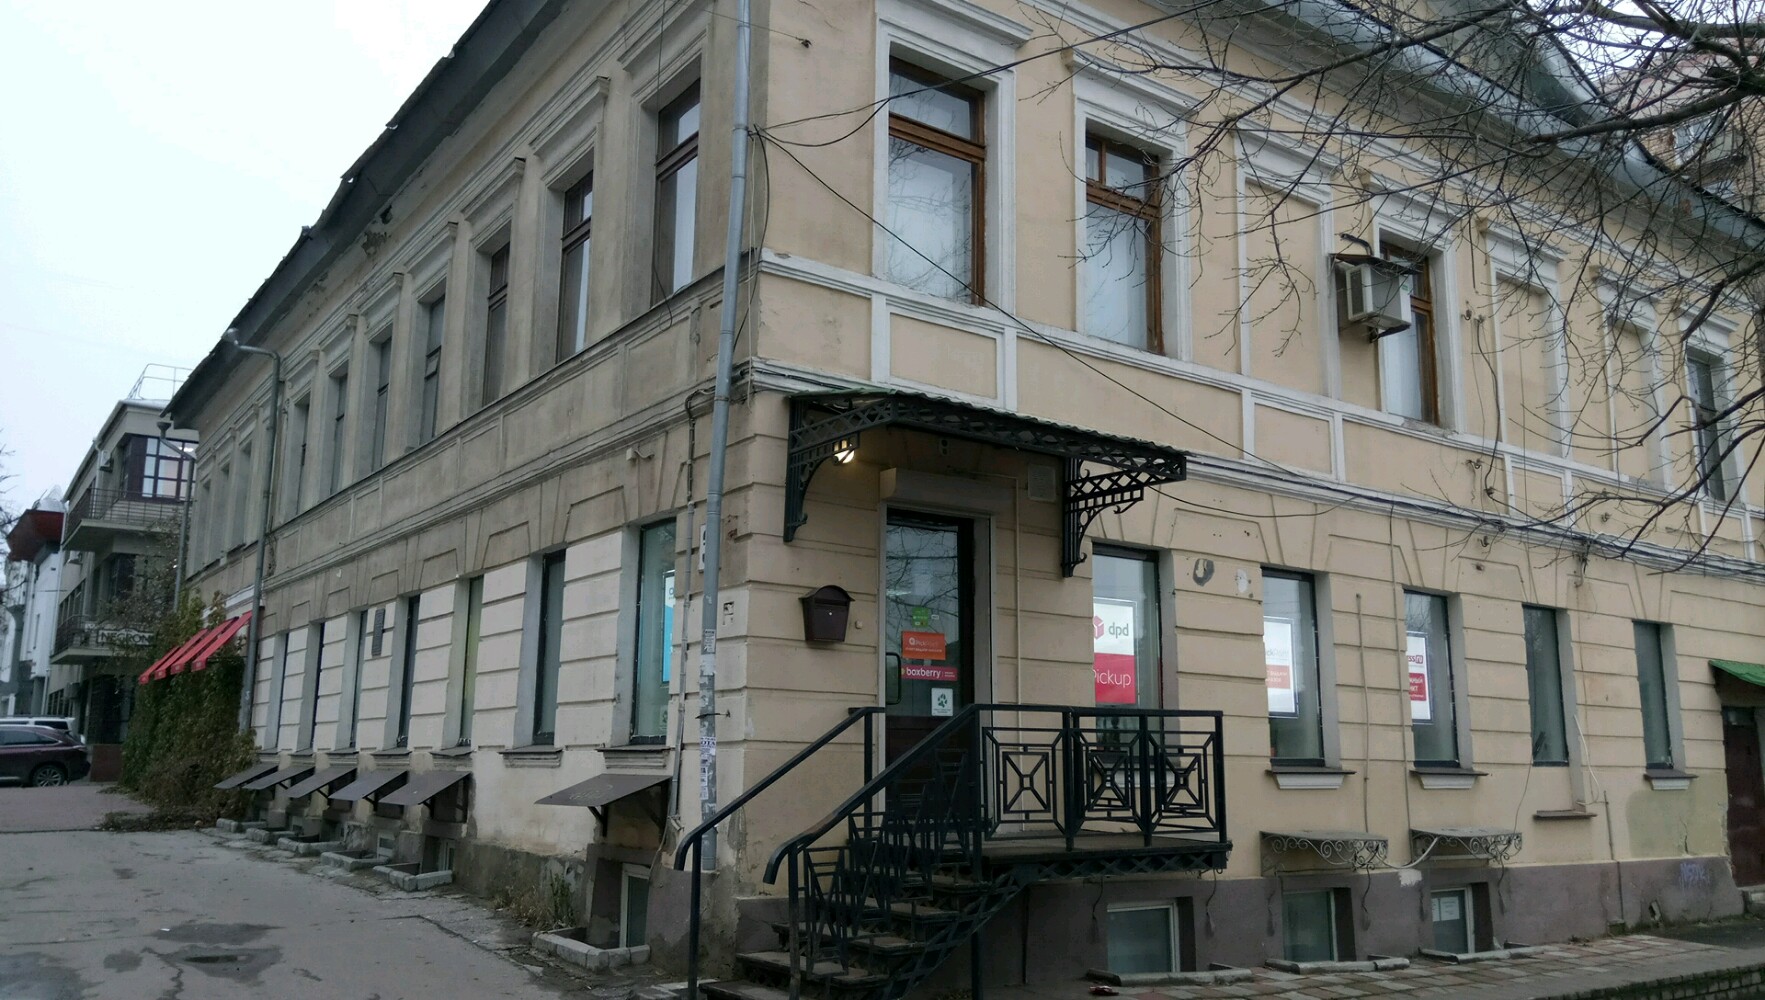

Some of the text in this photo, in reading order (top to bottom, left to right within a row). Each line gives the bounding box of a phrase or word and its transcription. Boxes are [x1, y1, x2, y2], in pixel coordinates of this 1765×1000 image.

[1108, 622, 1129, 639] dpd
[101, 632, 153, 643] NEGRON
[906, 667, 941, 679] boxberry
